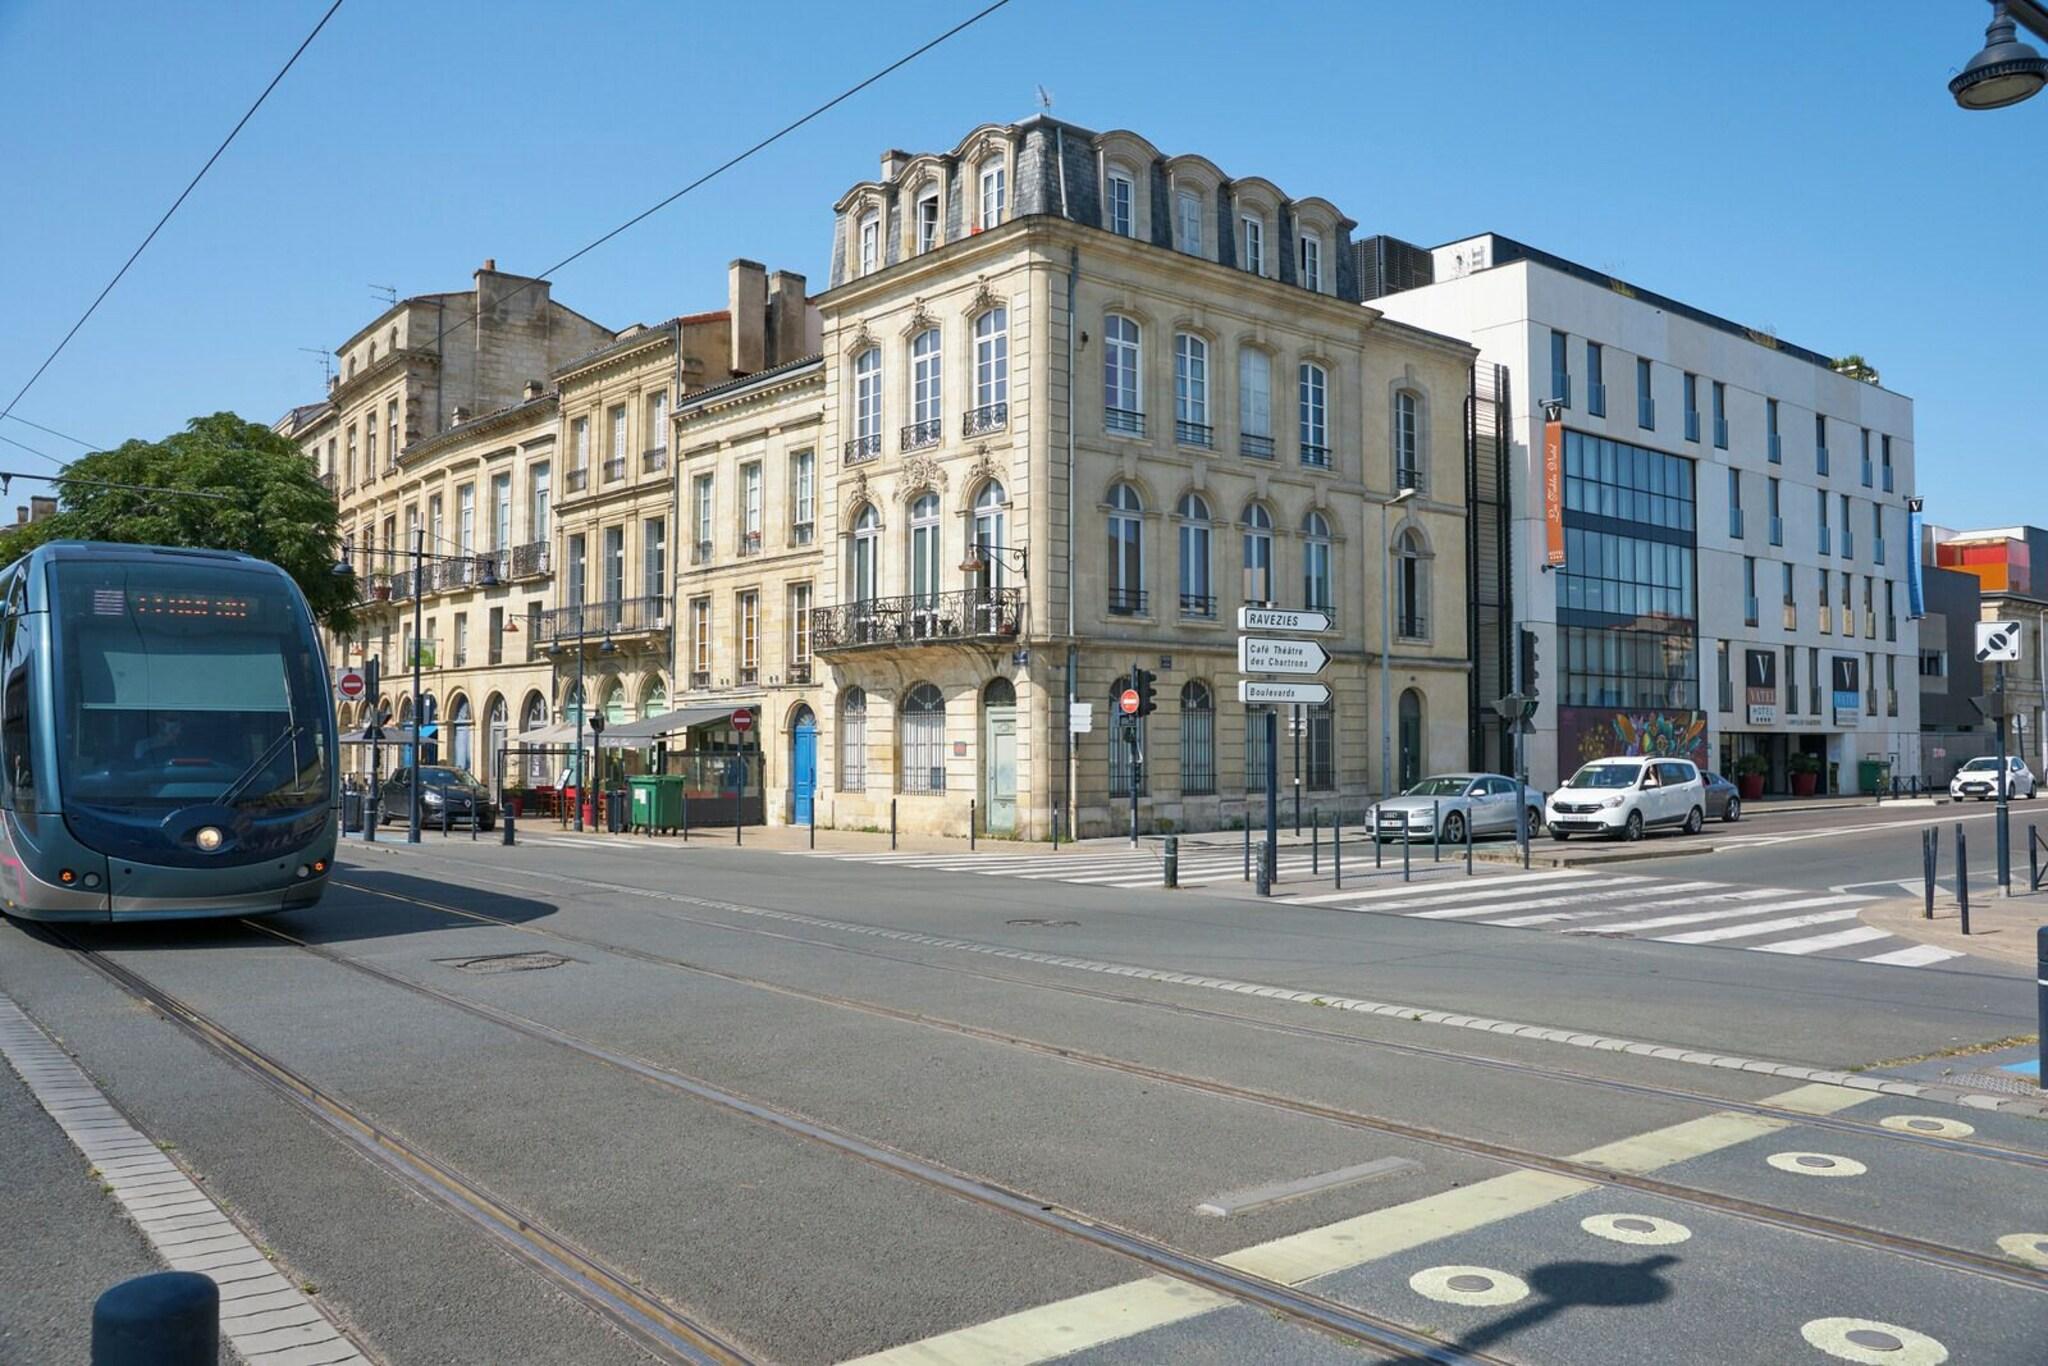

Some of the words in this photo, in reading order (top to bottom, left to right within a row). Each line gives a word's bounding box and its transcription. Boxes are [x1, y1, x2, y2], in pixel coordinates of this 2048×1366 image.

[1548, 406, 1559, 421] V
[1912, 501, 1920, 511] V
[1250, 614, 1298, 626] RAVEZIES
[1250, 645, 1269, 654] Café
[1274, 646, 1303, 655] Théâtre
[1250, 657, 1264, 665] des
[1268, 658, 1308, 667] Chartrons
[1757, 655, 1768, 684] V
[1842, 662, 1852, 688] V
[1250, 688, 1295, 697] Boulevards
